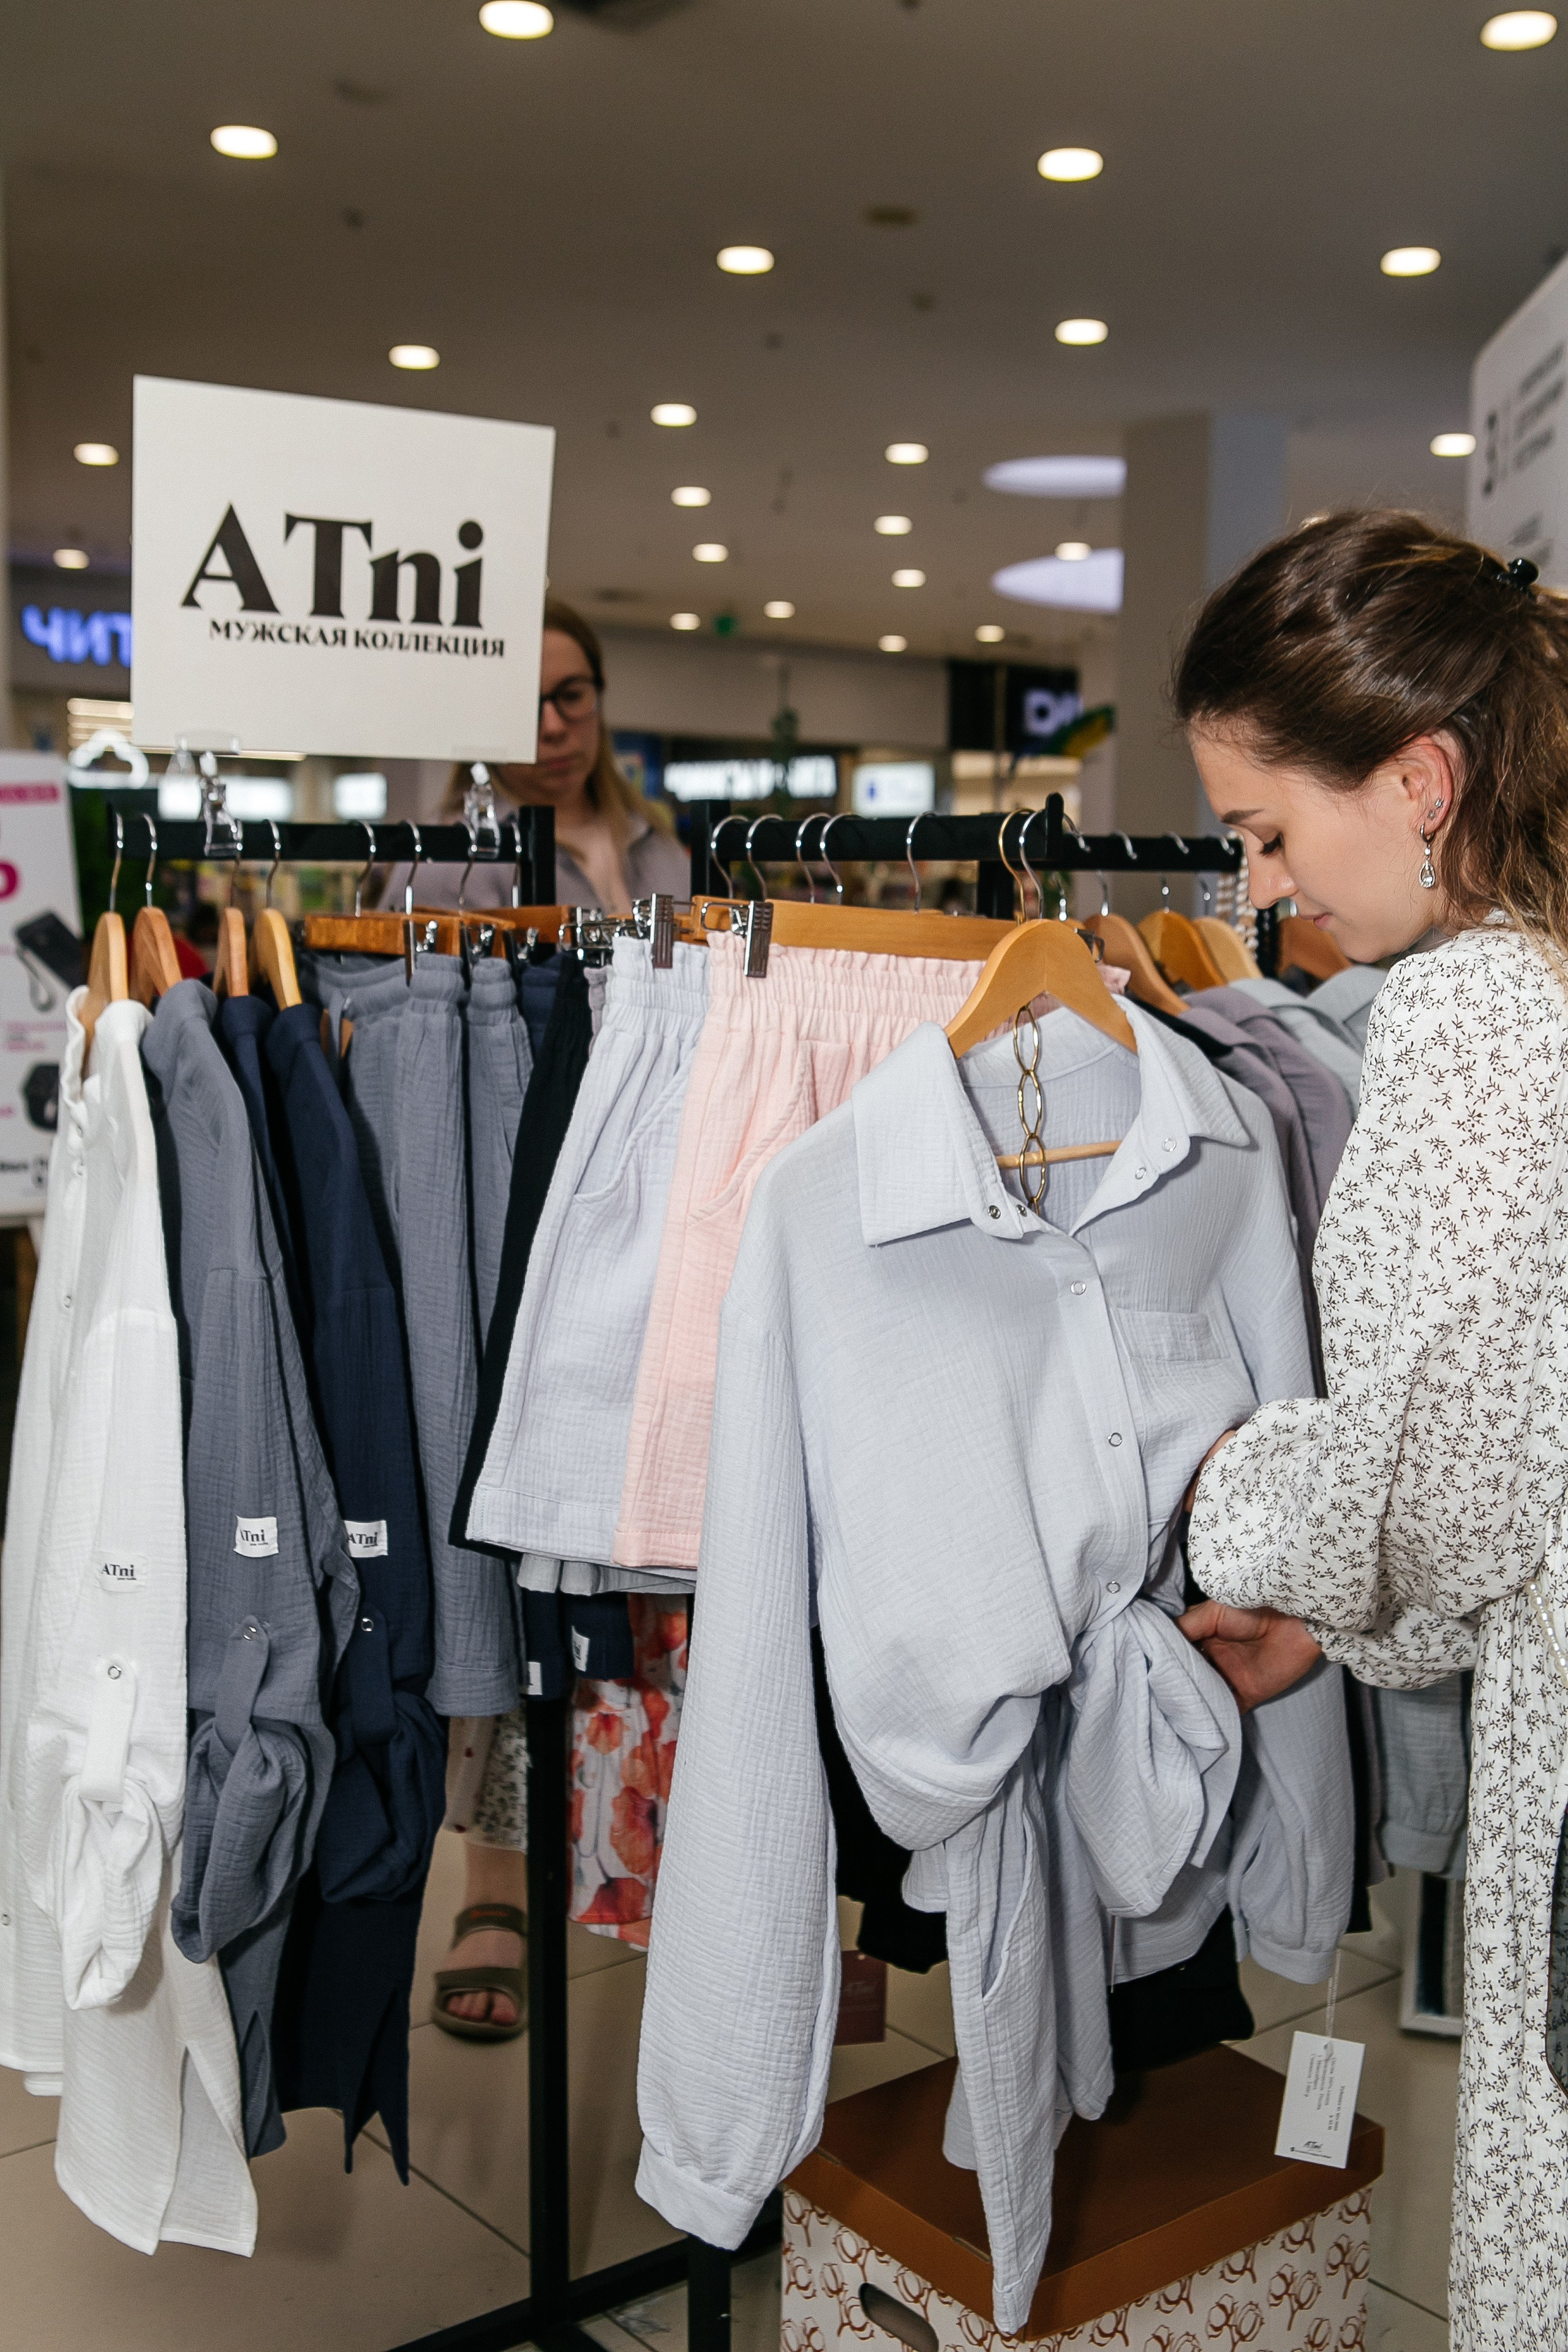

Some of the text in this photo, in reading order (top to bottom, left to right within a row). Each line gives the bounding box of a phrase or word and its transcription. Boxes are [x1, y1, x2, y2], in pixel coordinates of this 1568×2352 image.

[181, 501, 484, 628] ATni
[209, 618, 505, 658] МУЖСКАЯ КОЛЛЕКЦИЯ
[347, 1532, 378, 1544] ATni
[100, 1563, 134, 1577] ATni
